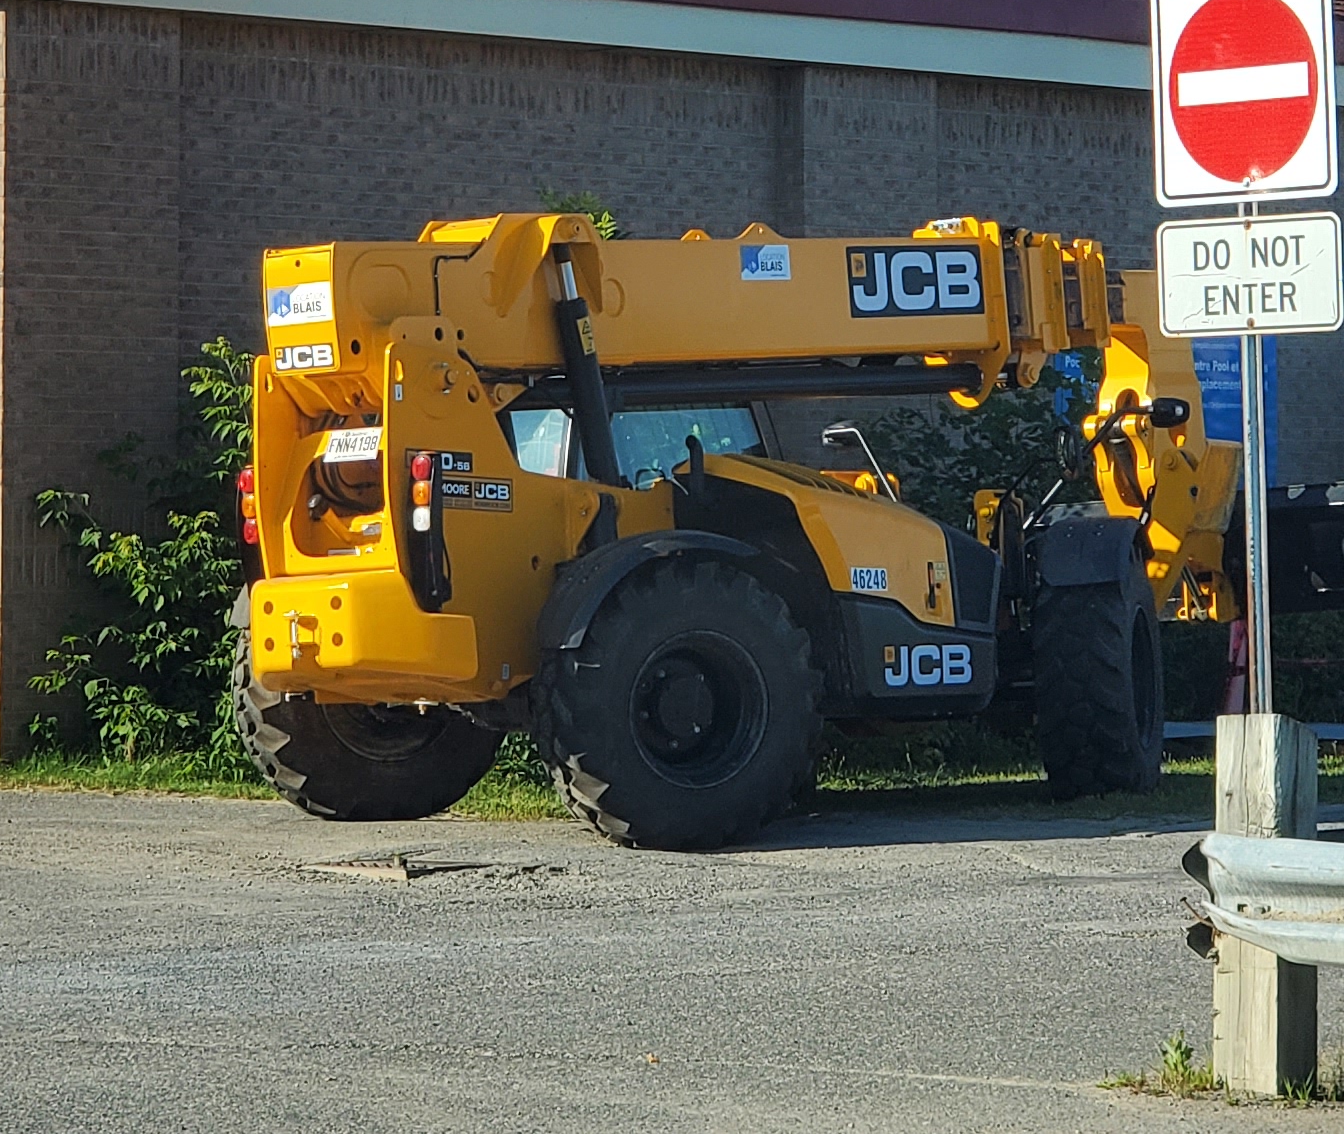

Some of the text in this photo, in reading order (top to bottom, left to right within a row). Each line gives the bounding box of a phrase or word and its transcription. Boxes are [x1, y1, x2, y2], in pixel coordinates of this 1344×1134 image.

[1192, 235, 1306, 272] DO NOT
[760, 261, 783, 271] BLAIS
[852, 251, 981, 312] JCB
[293, 301, 322, 314] BLAIS
[1203, 281, 1298, 316] ENTER
[275, 344, 334, 370] JCB
[328, 435, 379, 454] FNN4198
[475, 483, 510, 500] JCB
[852, 568, 887, 590] 46248
[884, 644, 973, 686] JCB
